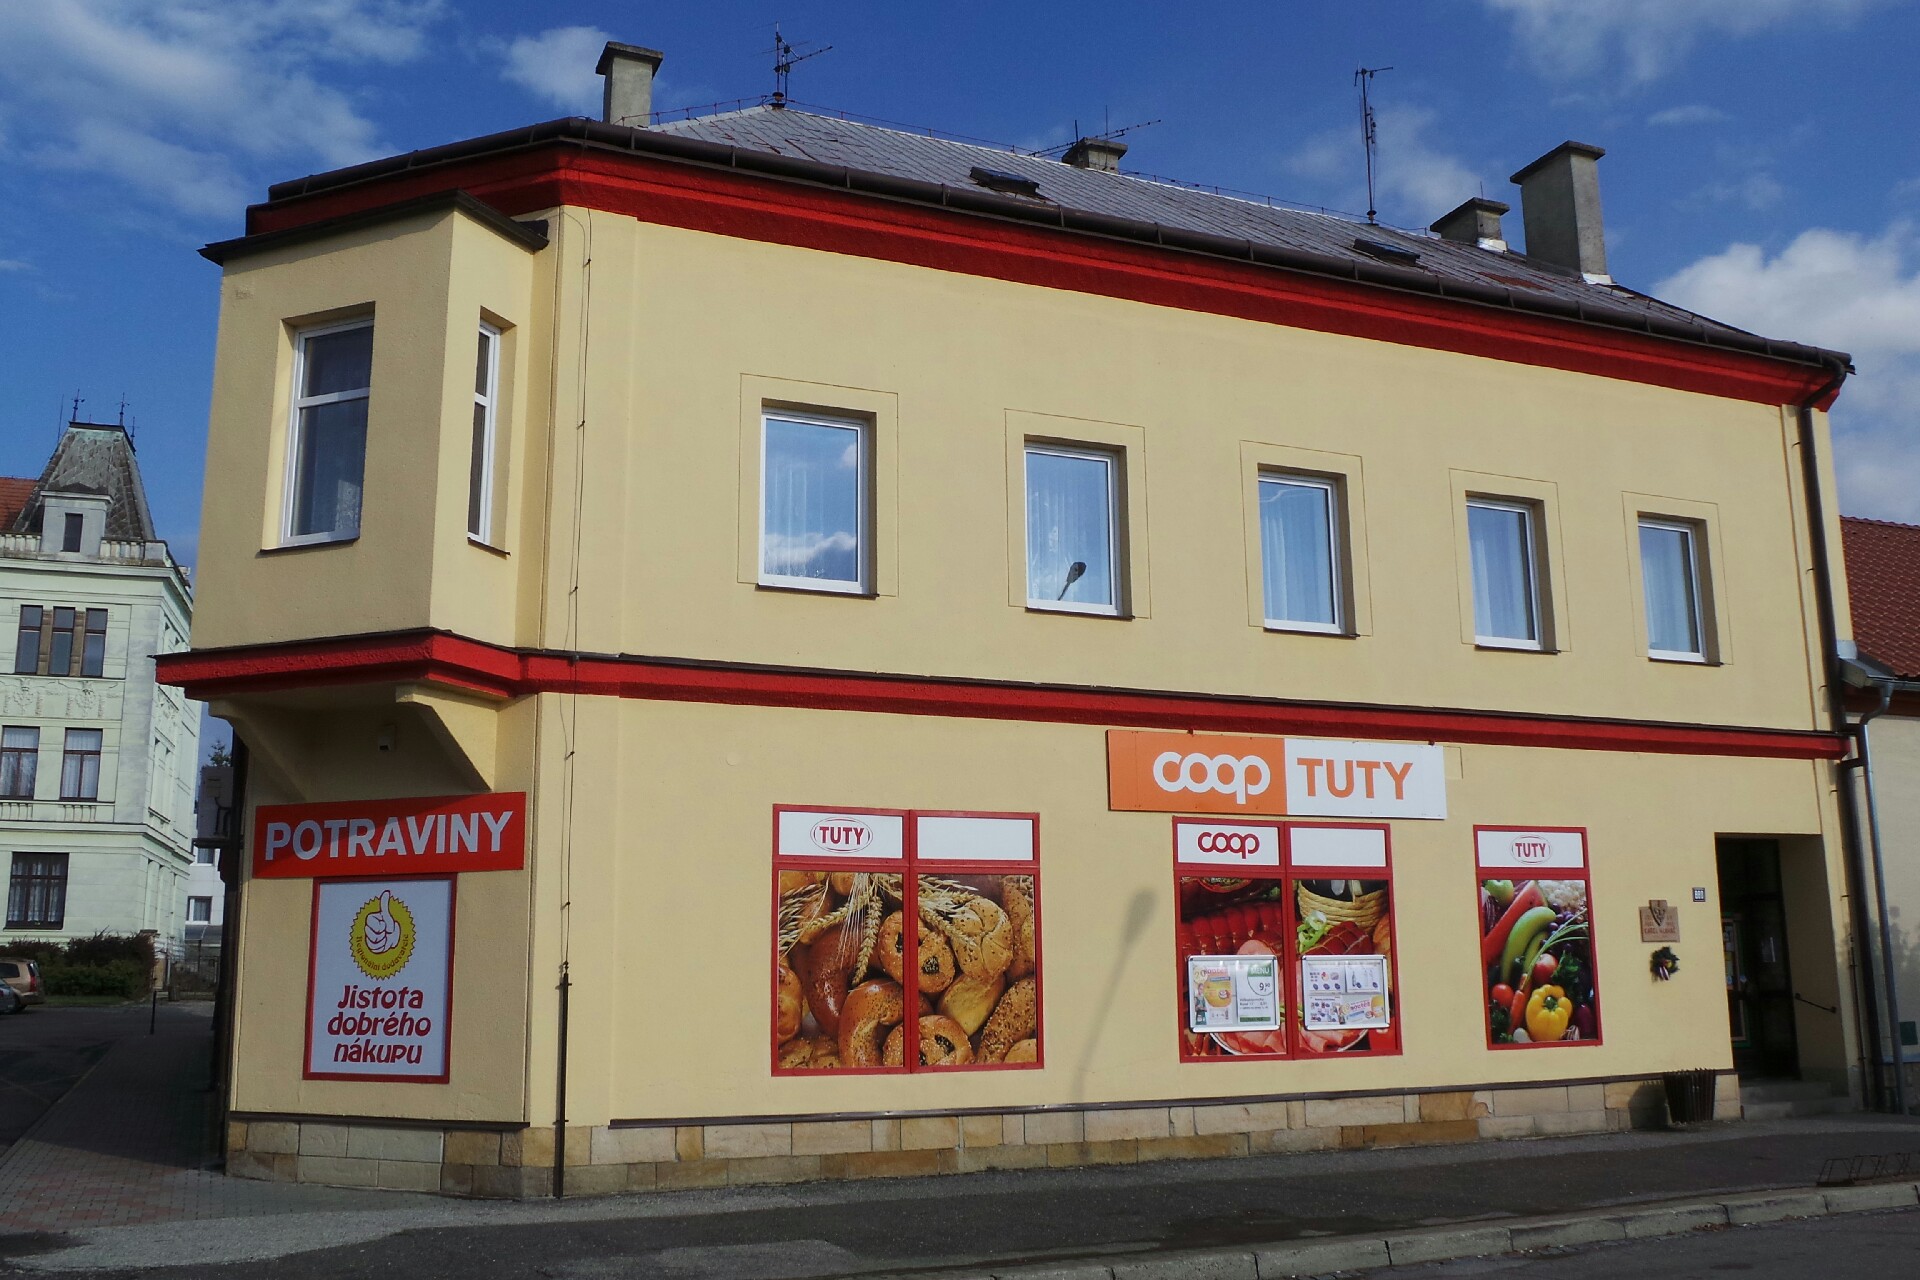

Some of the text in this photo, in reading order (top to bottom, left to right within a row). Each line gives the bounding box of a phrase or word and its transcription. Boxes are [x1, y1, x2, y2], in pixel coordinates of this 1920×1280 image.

[1153, 751, 1271, 805] coop
[1297, 757, 1413, 800] TUTY
[264, 810, 513, 861] POTRAVINY
[819, 826, 865, 845] TUTY
[1197, 831, 1260, 859] coop
[1515, 842, 1546, 858] TUTY
[337, 985, 423, 1009] Jistota
[327, 1011, 431, 1037] dobrého
[333, 1038, 422, 1064] nákupu
